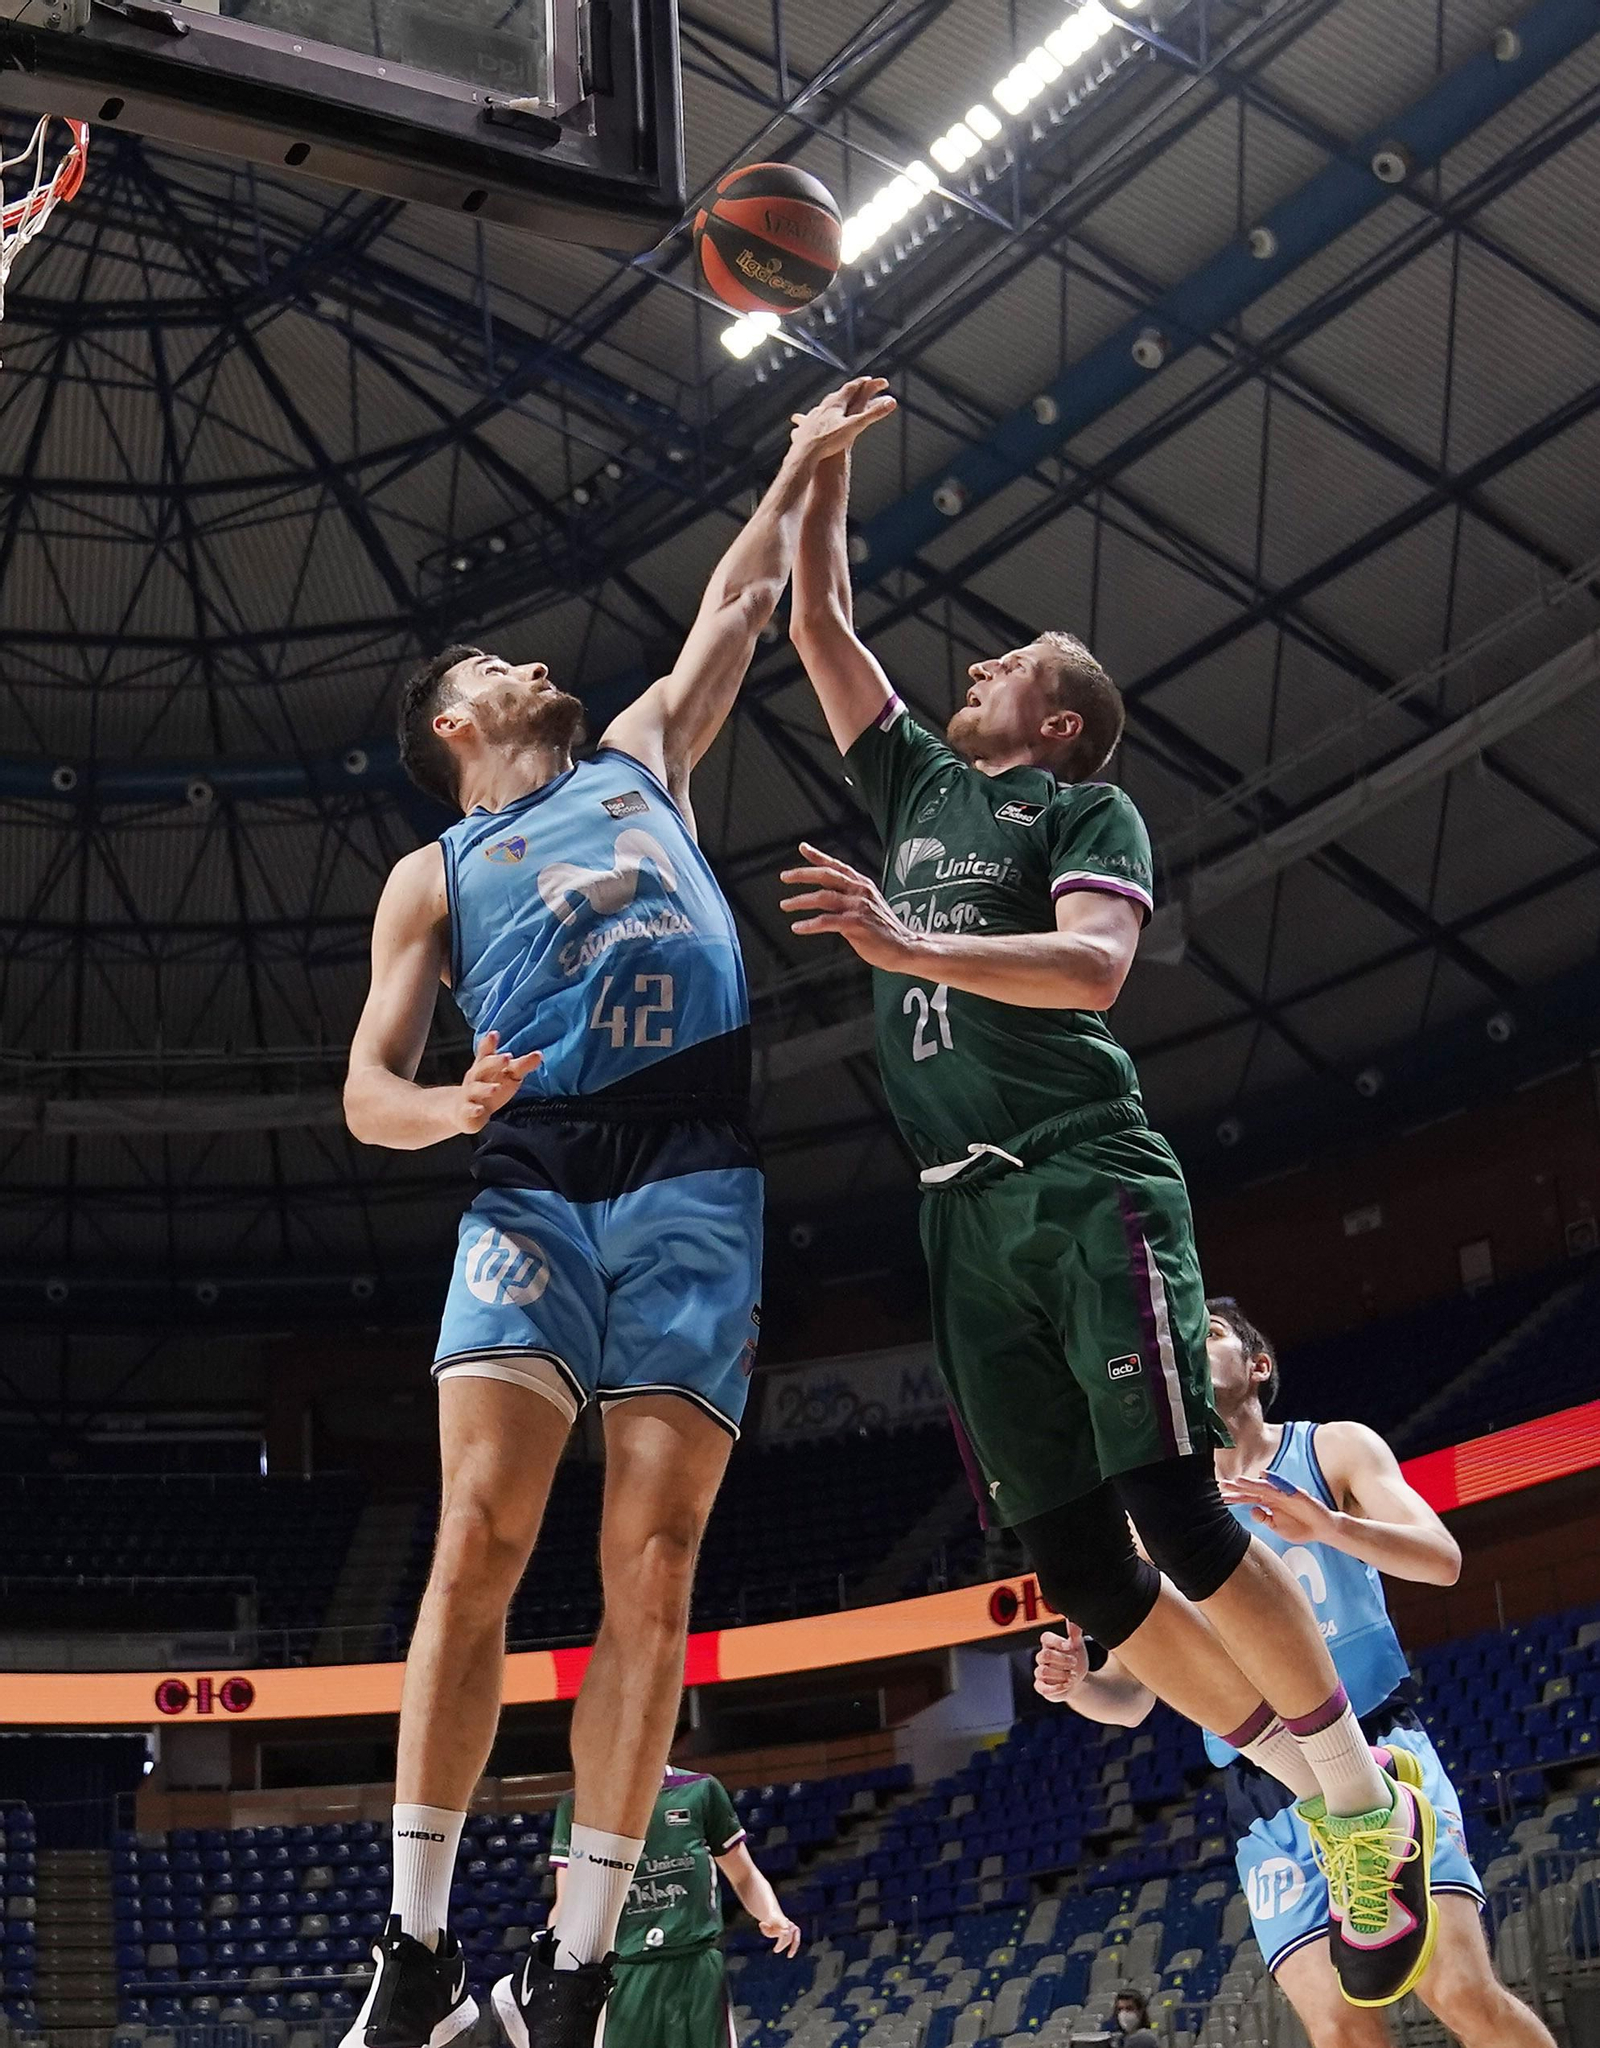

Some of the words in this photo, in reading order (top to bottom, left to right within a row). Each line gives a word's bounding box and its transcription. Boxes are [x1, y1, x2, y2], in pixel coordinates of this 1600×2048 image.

[935, 852, 1022, 886] Unicaja
[558, 908, 694, 976] Estudiantes
[590, 974, 673, 1047] 42
[903, 983, 954, 1061] 21
[471, 1229, 544, 1305] hp
[1112, 1363, 1133, 1376] acb
[990, 1579, 1060, 1626] CI
[398, 1831, 445, 1842] WIBO
[589, 1854, 635, 1871] WIBO
